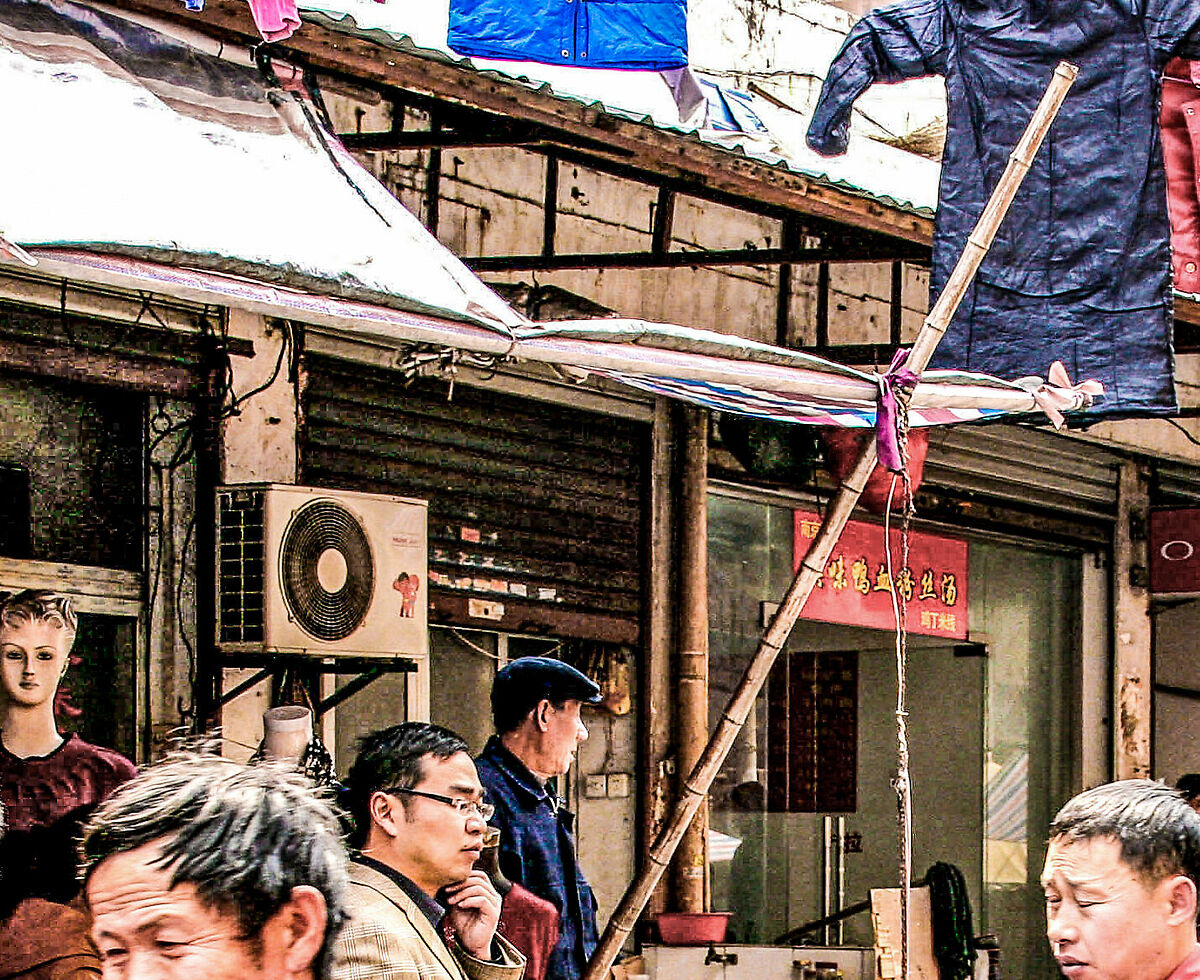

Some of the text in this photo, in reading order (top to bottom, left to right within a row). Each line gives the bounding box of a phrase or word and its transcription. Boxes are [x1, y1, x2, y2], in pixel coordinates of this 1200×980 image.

[816, 554, 957, 606] 味鸭血粉丝汤
